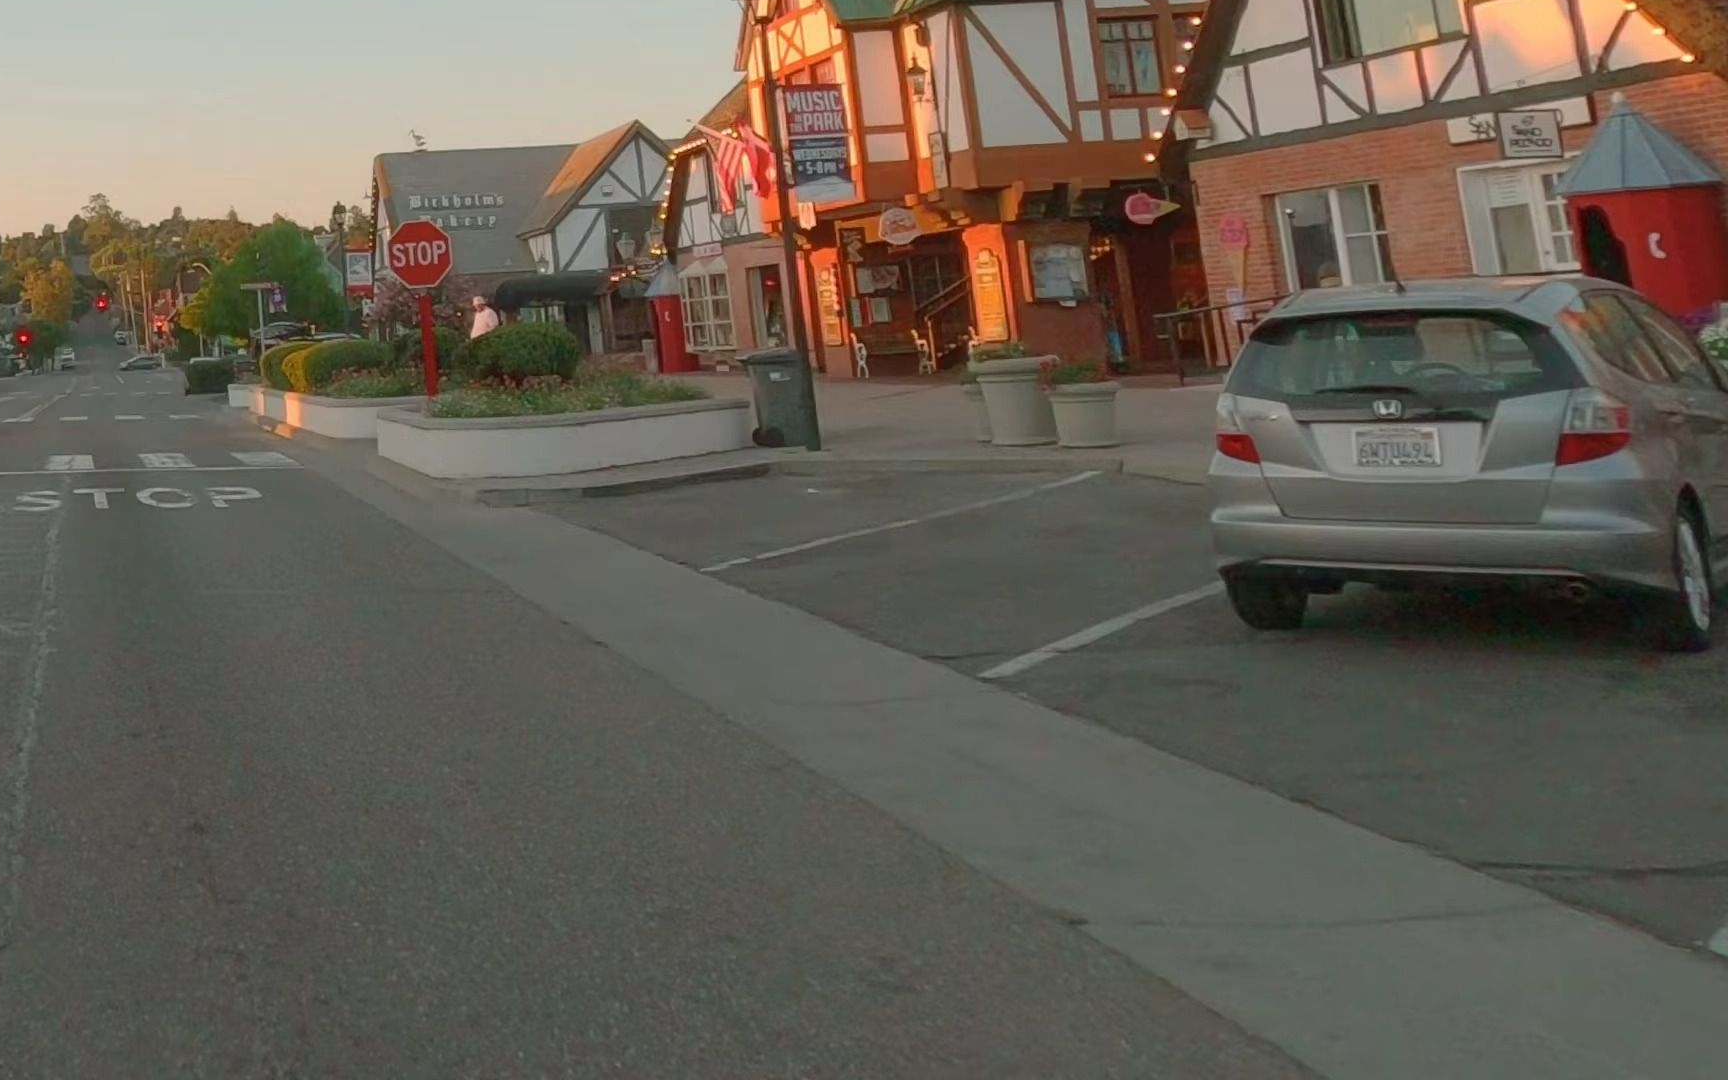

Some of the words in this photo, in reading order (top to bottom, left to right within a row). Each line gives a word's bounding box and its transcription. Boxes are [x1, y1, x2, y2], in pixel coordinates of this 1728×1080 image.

[785, 91, 842, 113] MUSIC
[803, 112, 844, 132] PARK
[408, 192, 505, 210] Birkholm's
[391, 240, 447, 267] STOP
[13, 486, 263, 512] STOP
